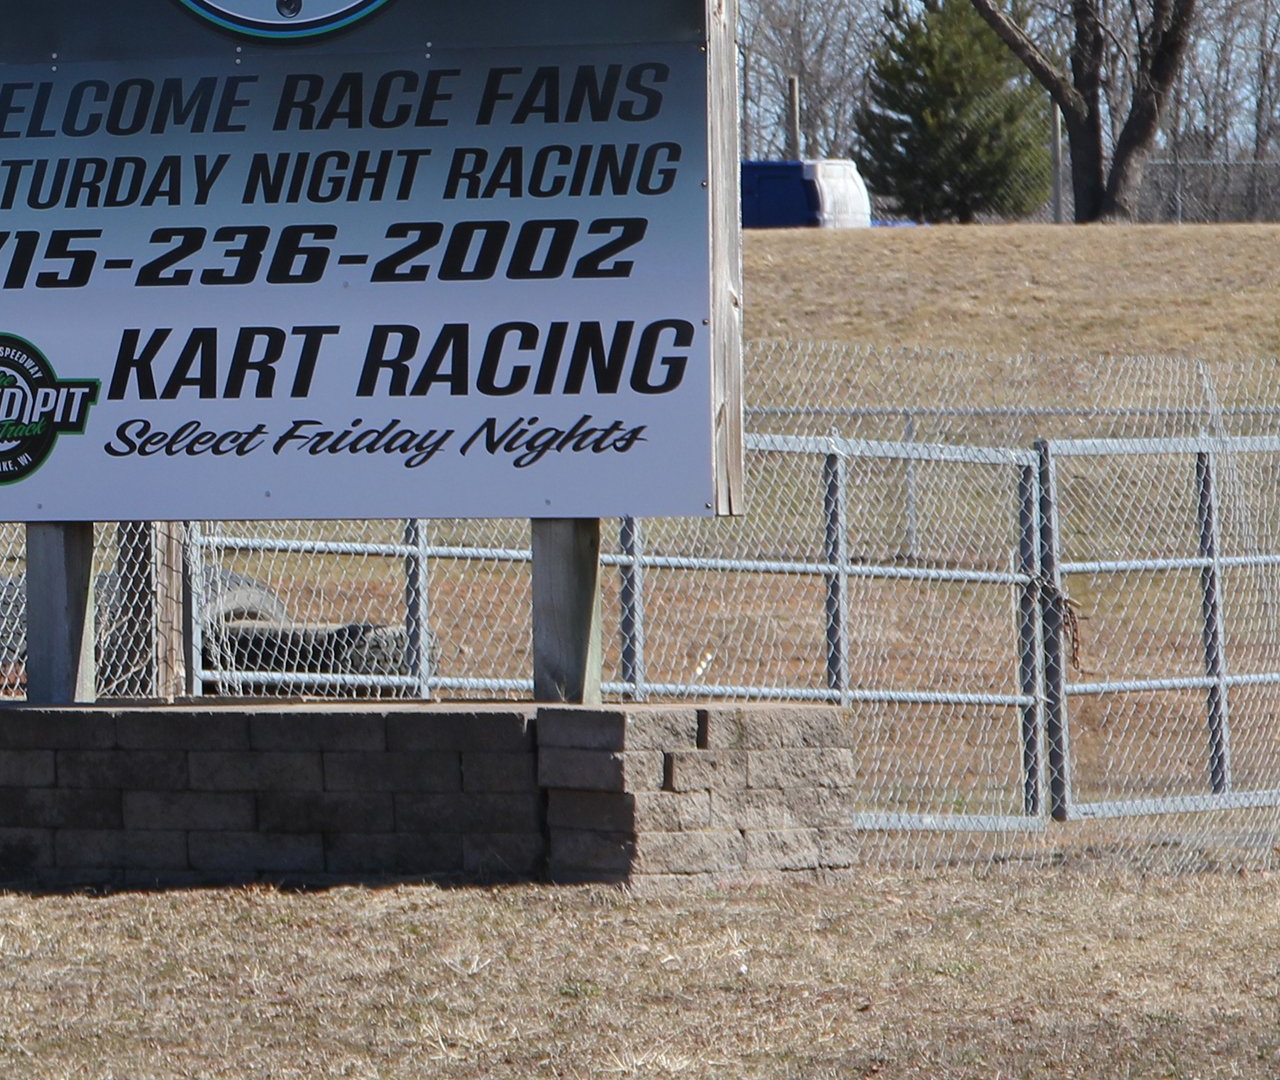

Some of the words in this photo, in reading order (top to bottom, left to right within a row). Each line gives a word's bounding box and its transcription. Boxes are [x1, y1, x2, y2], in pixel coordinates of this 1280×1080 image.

[272, 68, 462, 131] RACE
[475, 62, 671, 126] FANS
[241, 148, 432, 205] NIGHT
[442, 141, 683, 200] RACING
[106, 324, 341, 400] KART
[355, 318, 695, 397] RACING
[17, 452, 33, 467] WI
[104, 418, 269, 457] Select
[272, 418, 455, 468] Friday
[459, 414, 648, 468] Nights
